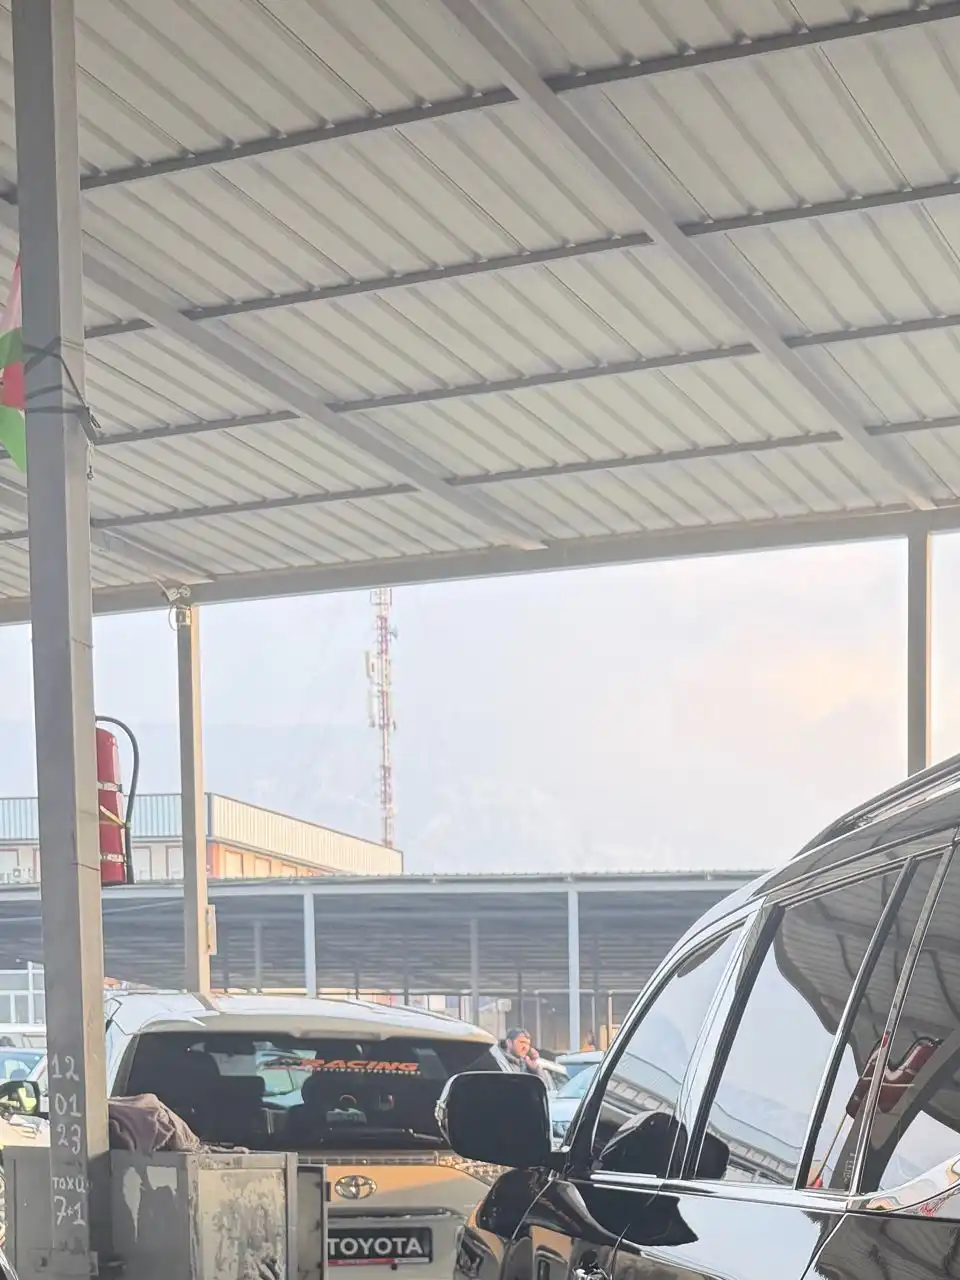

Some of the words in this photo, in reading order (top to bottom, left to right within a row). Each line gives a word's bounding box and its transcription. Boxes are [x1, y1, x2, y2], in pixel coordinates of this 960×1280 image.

[52, 1053, 80, 1081] 12
[300, 1059, 419, 1071] RACING
[55, 1092, 82, 1117] 01
[56, 1123, 81, 1155] 23
[327, 1237, 423, 1255] TOYOTA
